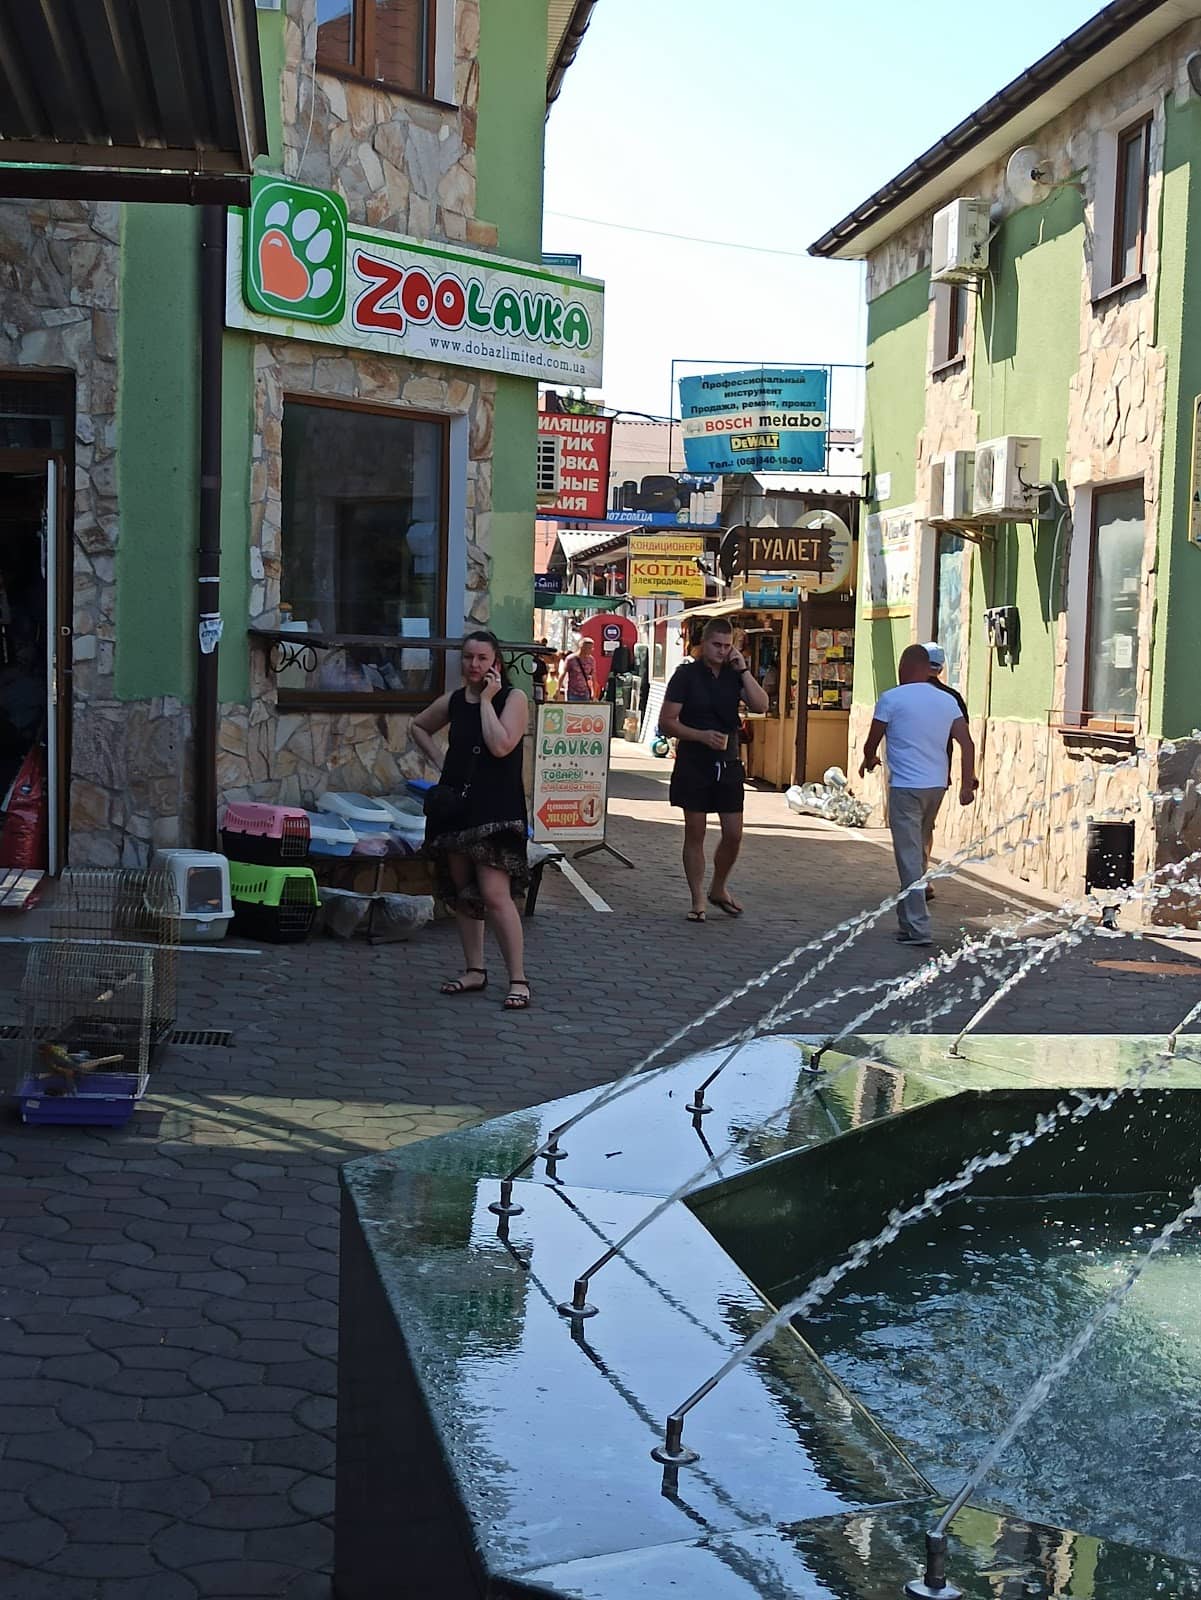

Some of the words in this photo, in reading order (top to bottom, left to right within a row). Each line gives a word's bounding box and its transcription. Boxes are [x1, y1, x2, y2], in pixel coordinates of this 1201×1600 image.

[353, 250, 592, 349] ZOOLAVKA
[429, 336, 586, 375] www.dobazlimited.com.ua
[702, 376, 806, 390] Профессиональный
[724, 389, 783, 399] инструмент
[691, 403, 739, 415] Продажа,
[742, 400, 779, 410] ремонт,
[782, 400, 817, 409] прокат
[705, 417, 753, 432] BOSCH
[759, 413, 822, 428] metabo
[630, 540, 702, 552] КОНДИЦИОНЕРЫ
[749, 537, 822, 560] ТУАЛЕТ
[565, 714, 606, 735] ZOO
[542, 738, 604, 757] LAVKA
